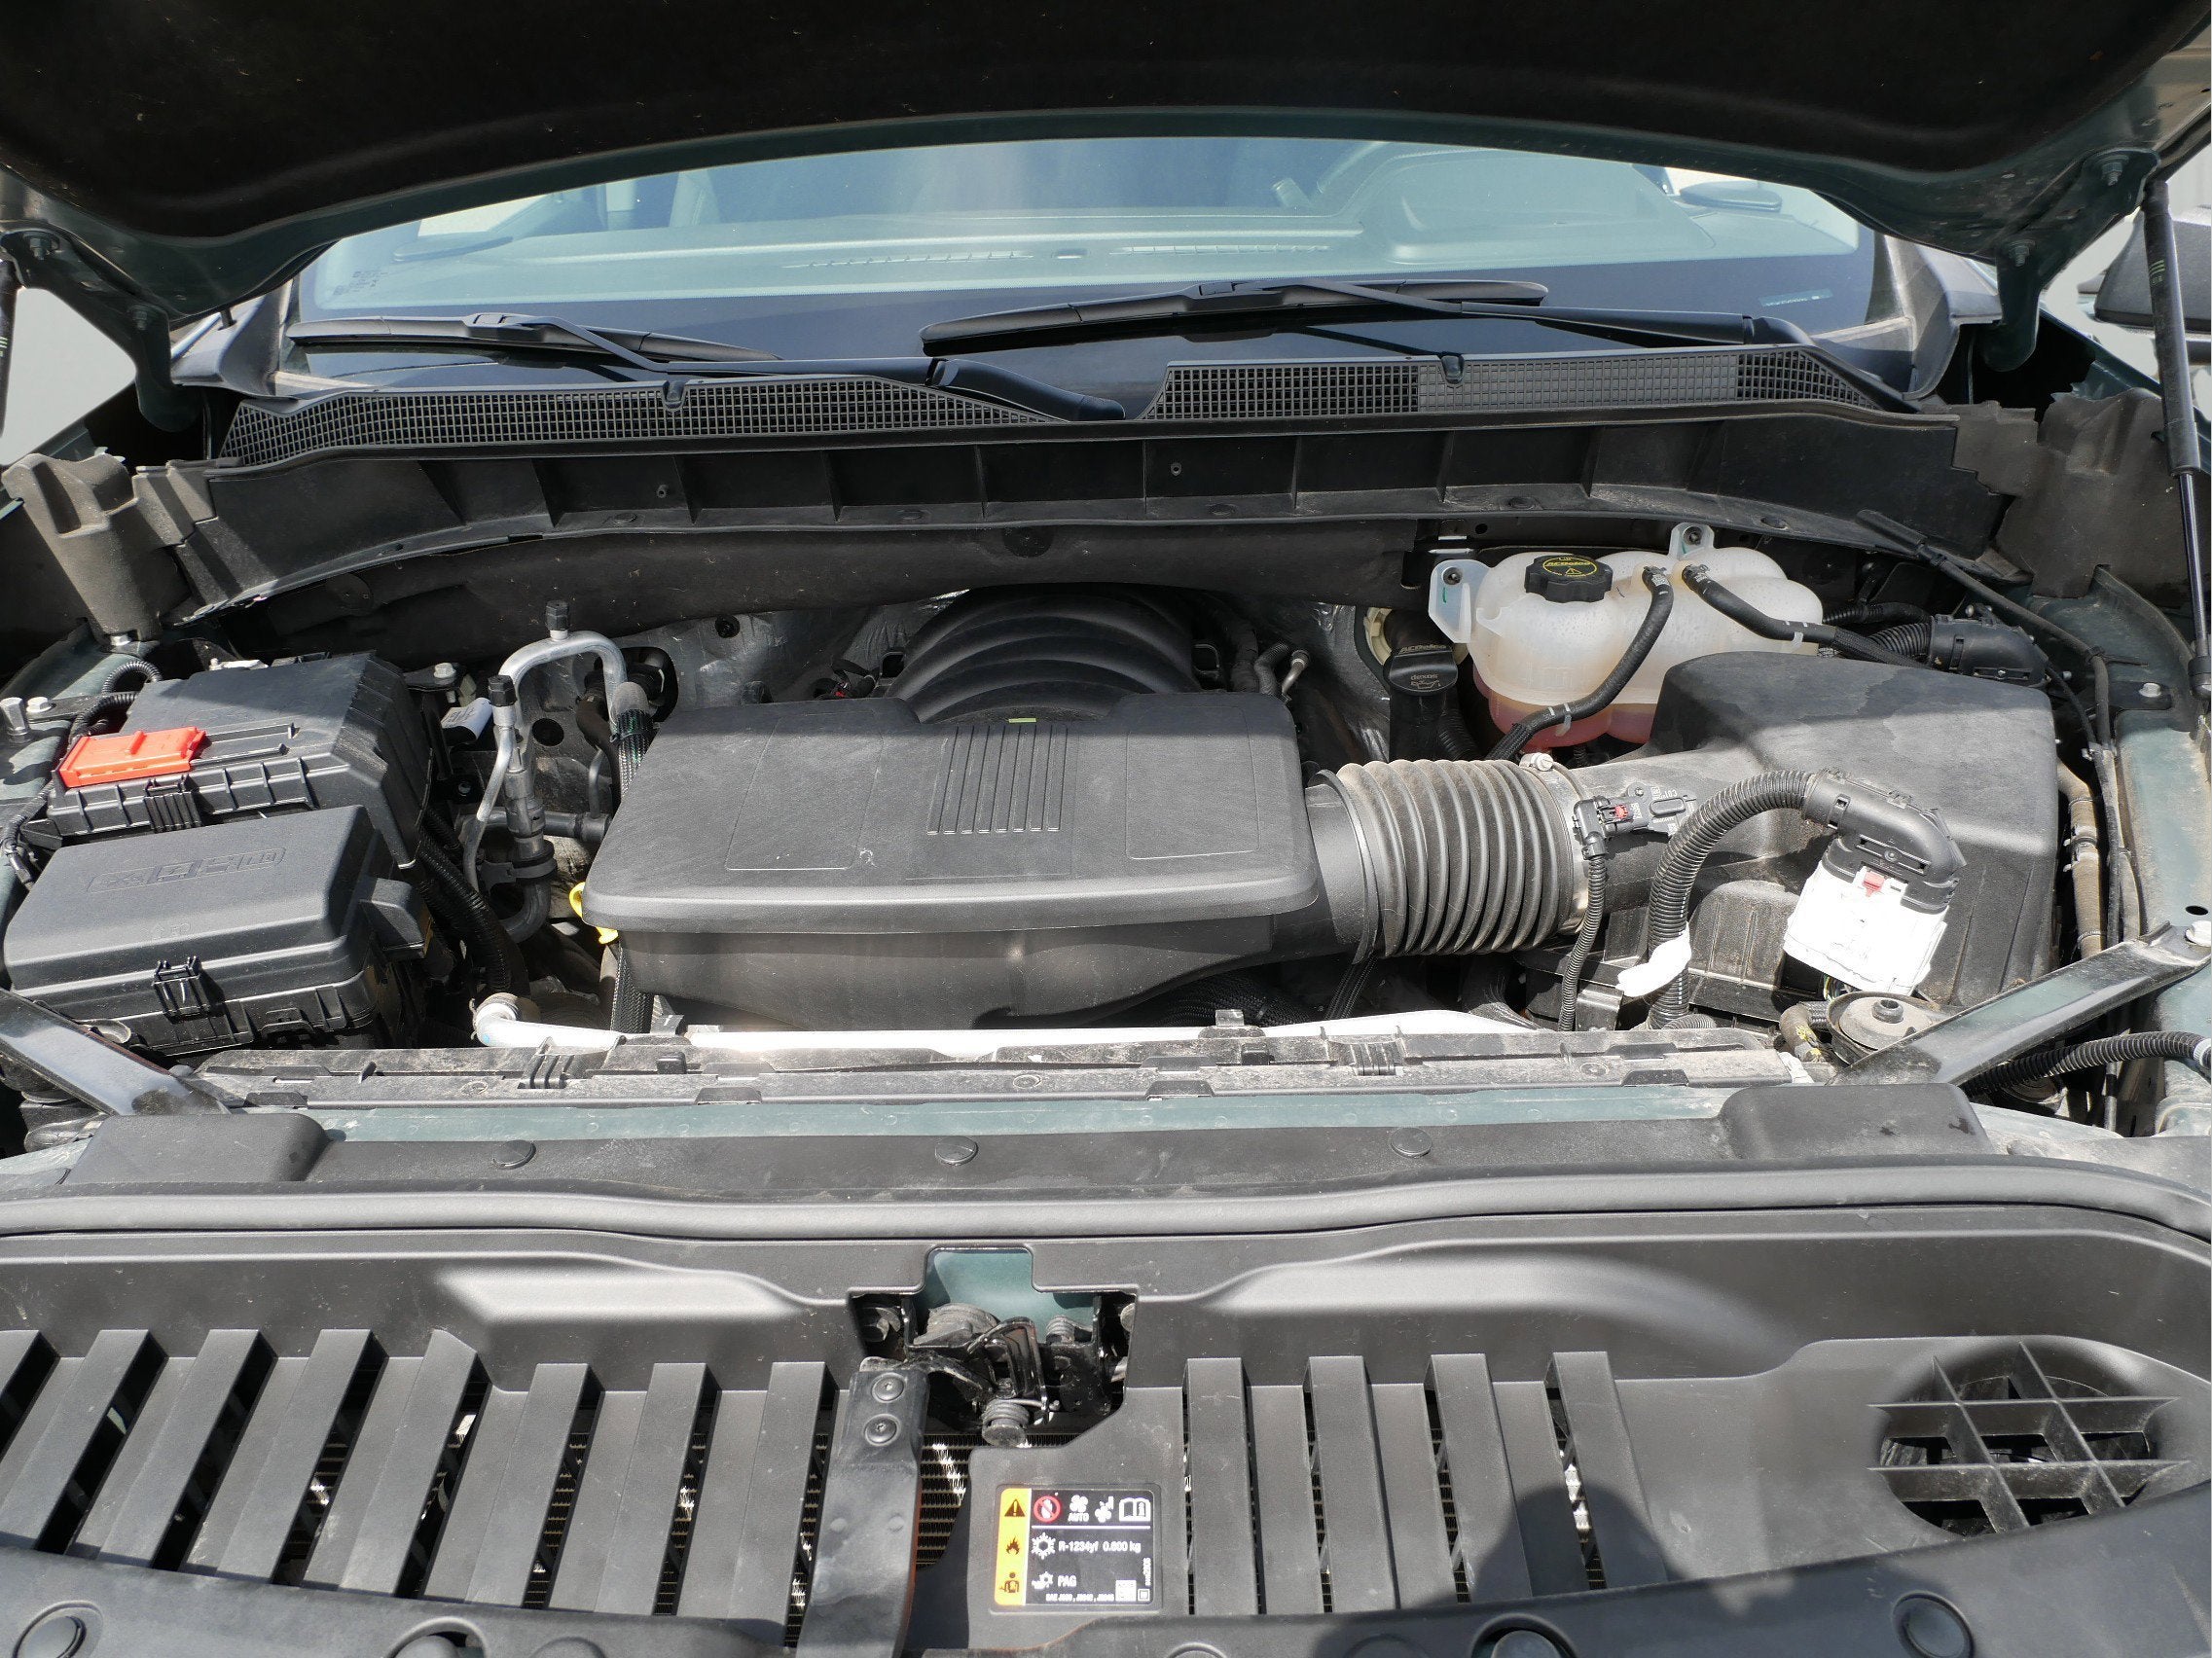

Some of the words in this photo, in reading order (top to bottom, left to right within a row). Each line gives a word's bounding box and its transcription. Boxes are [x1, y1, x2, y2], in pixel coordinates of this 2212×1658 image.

[1068, 1513, 1089, 1522] AUTO
[1059, 1541, 1099, 1553] R-1234yf
[1130, 1541, 1141, 1554] kg
[1058, 1575, 1076, 1587] PAG
